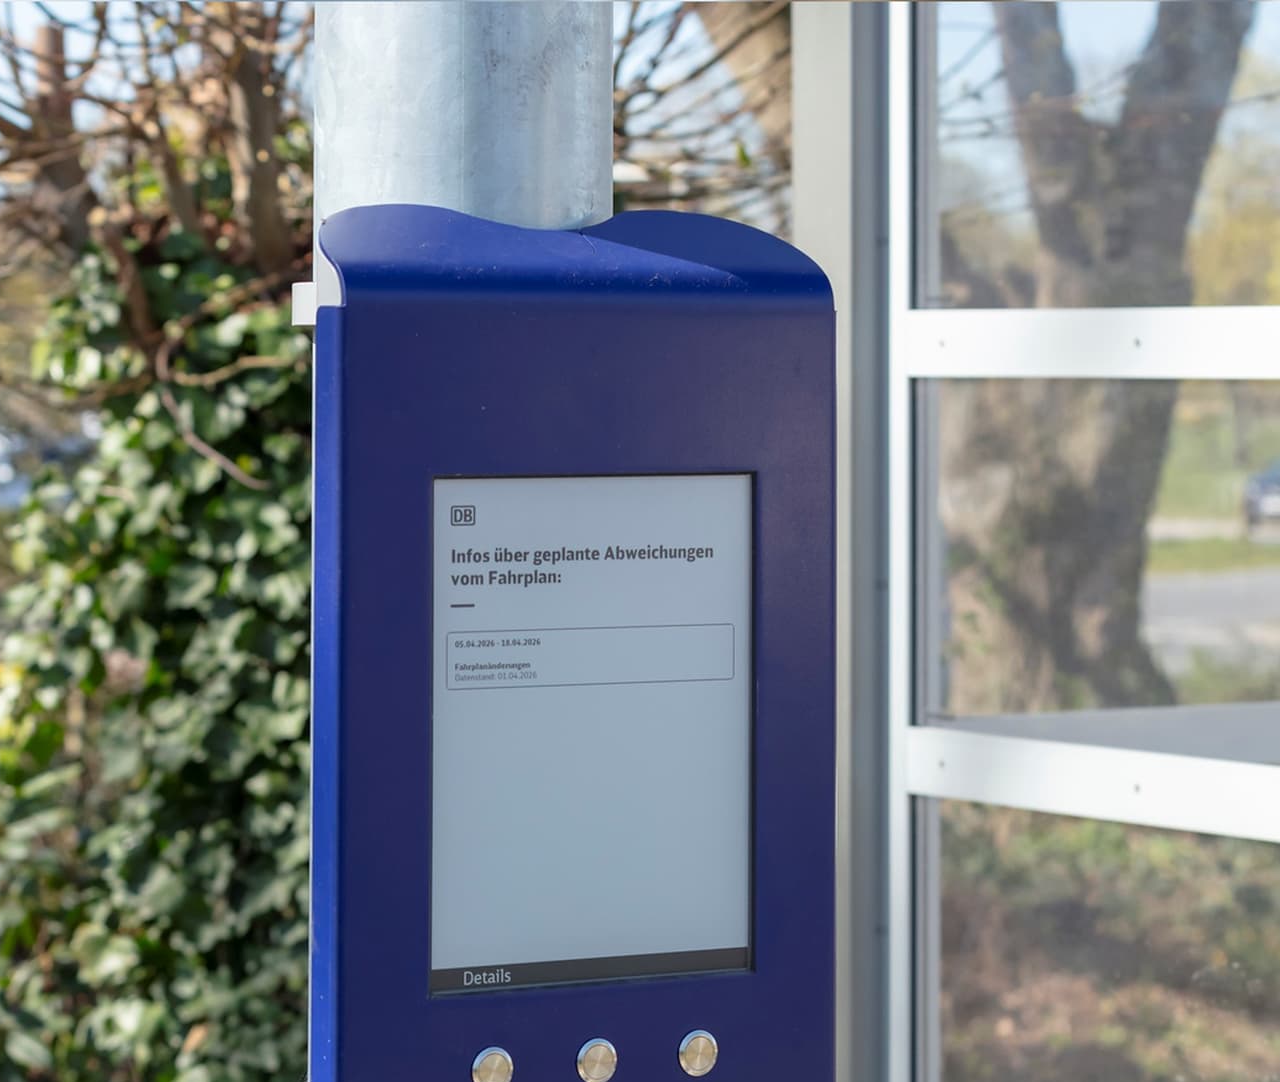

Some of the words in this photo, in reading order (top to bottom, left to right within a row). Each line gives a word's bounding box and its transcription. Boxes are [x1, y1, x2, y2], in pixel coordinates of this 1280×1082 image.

[453, 508, 473, 523] DB
[451, 549, 490, 564] Infos
[494, 547, 530, 563] über
[533, 547, 600, 565] geplante
[604, 545, 714, 563] Abweichungen
[451, 573, 484, 586] vom
[488, 570, 562, 588] Fahrplan:
[454, 661, 531, 671] Fahrplanänderungen
[454, 672, 495, 682] Datenstand:
[463, 969, 511, 986] Details
